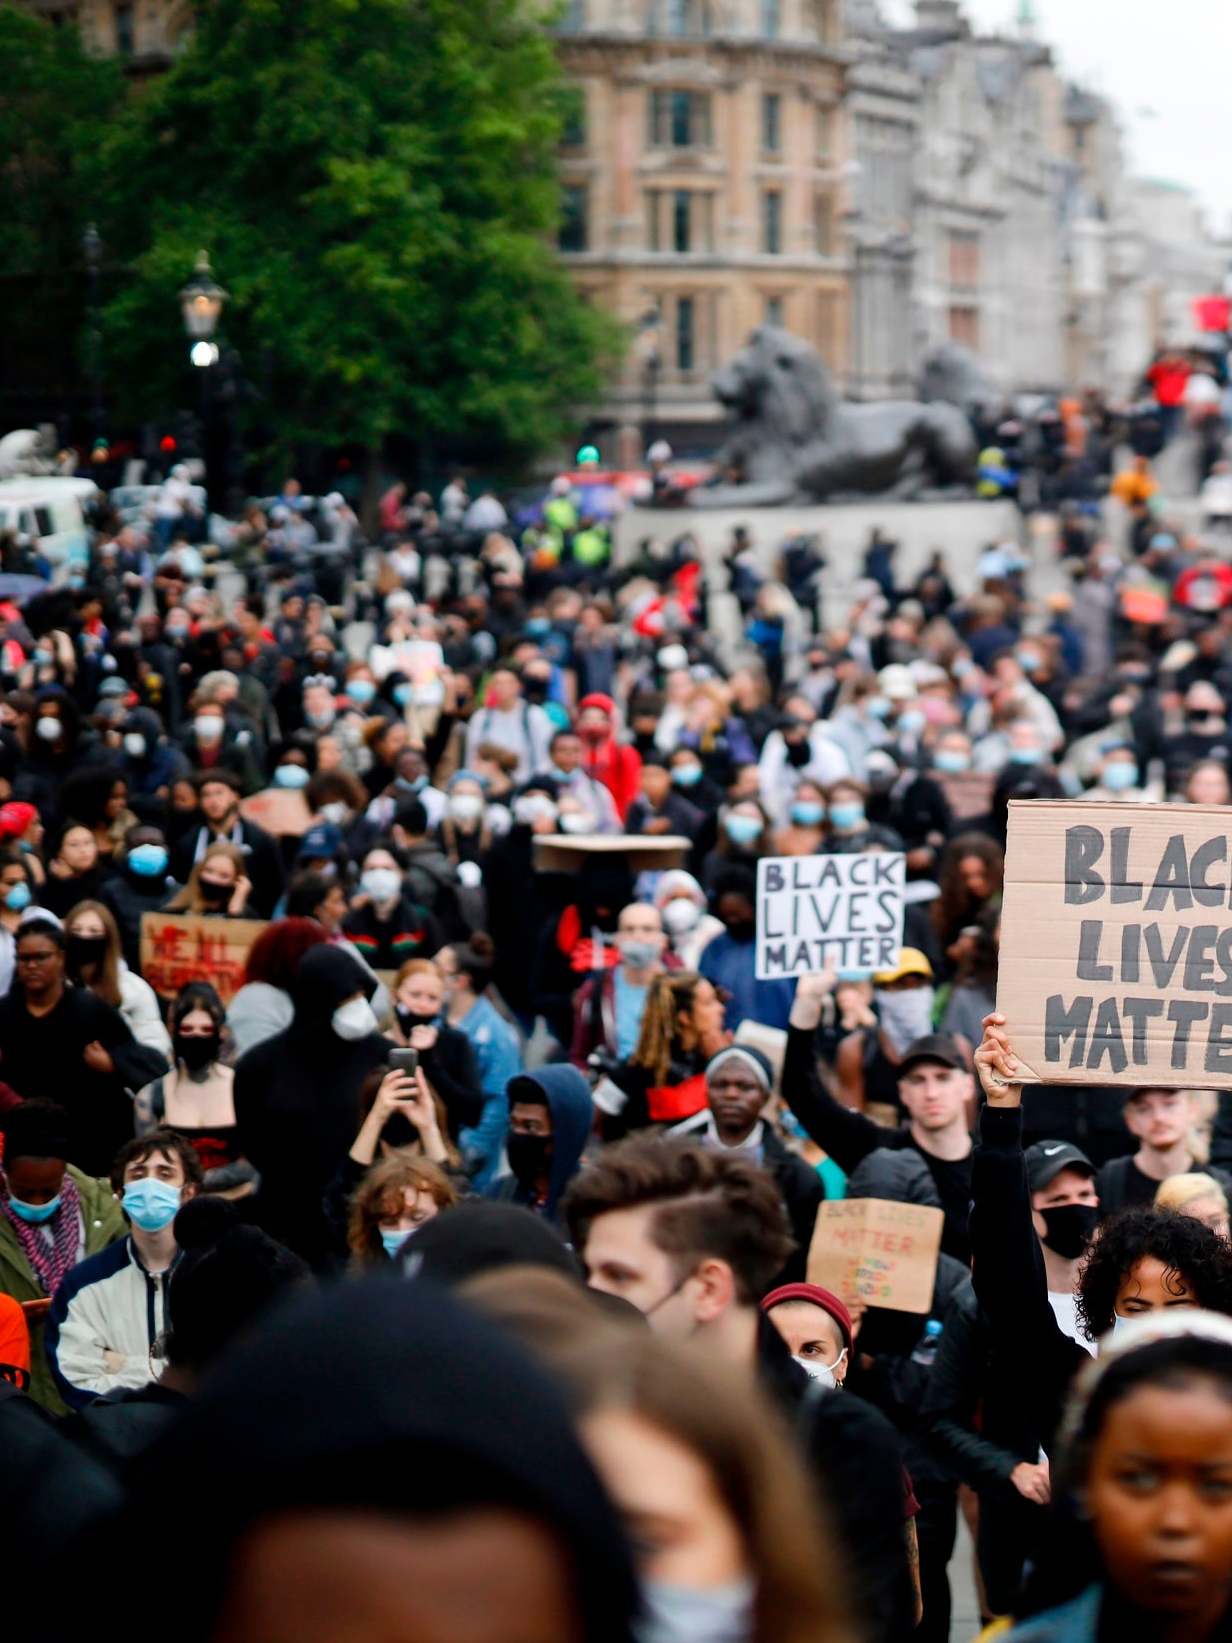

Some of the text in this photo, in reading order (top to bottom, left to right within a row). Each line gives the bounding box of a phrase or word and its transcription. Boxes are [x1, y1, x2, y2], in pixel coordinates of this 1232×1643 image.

[764, 857, 901, 893] BLACK
[764, 890, 899, 939] LIVES
[764, 937, 898, 975] MATTER
[832, 1228, 914, 1257] MATTER
